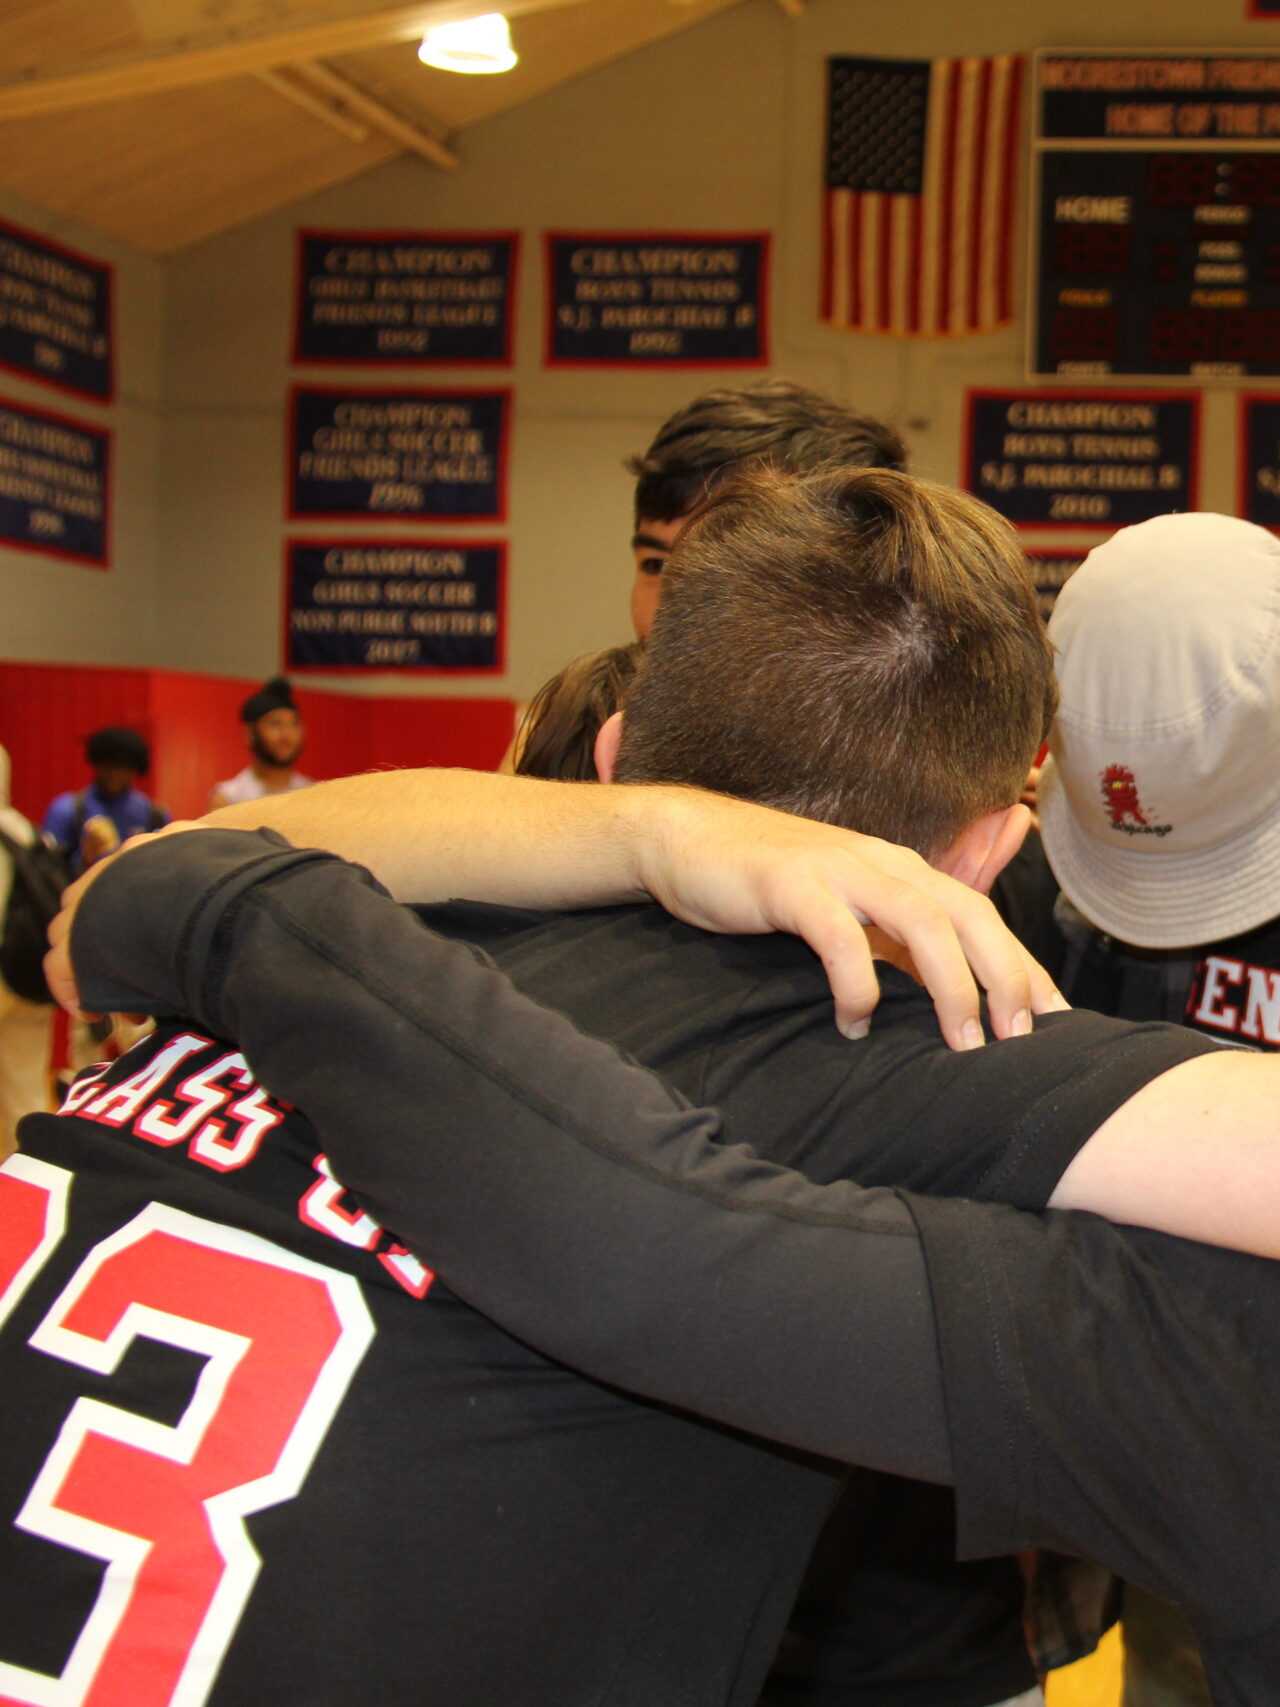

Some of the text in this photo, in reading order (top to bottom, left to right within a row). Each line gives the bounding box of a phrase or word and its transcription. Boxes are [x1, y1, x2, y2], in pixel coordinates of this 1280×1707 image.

[1055, 198, 1129, 224] HOME
[325, 249, 491, 272] CHAMPION
[572, 249, 740, 273] CHAMPION
[334, 404, 468, 427] CHAMPION
[1007, 404, 1154, 429] CHAMPION
[325, 551, 464, 574] CHAMPION
[58, 1032, 285, 1173] LASS
